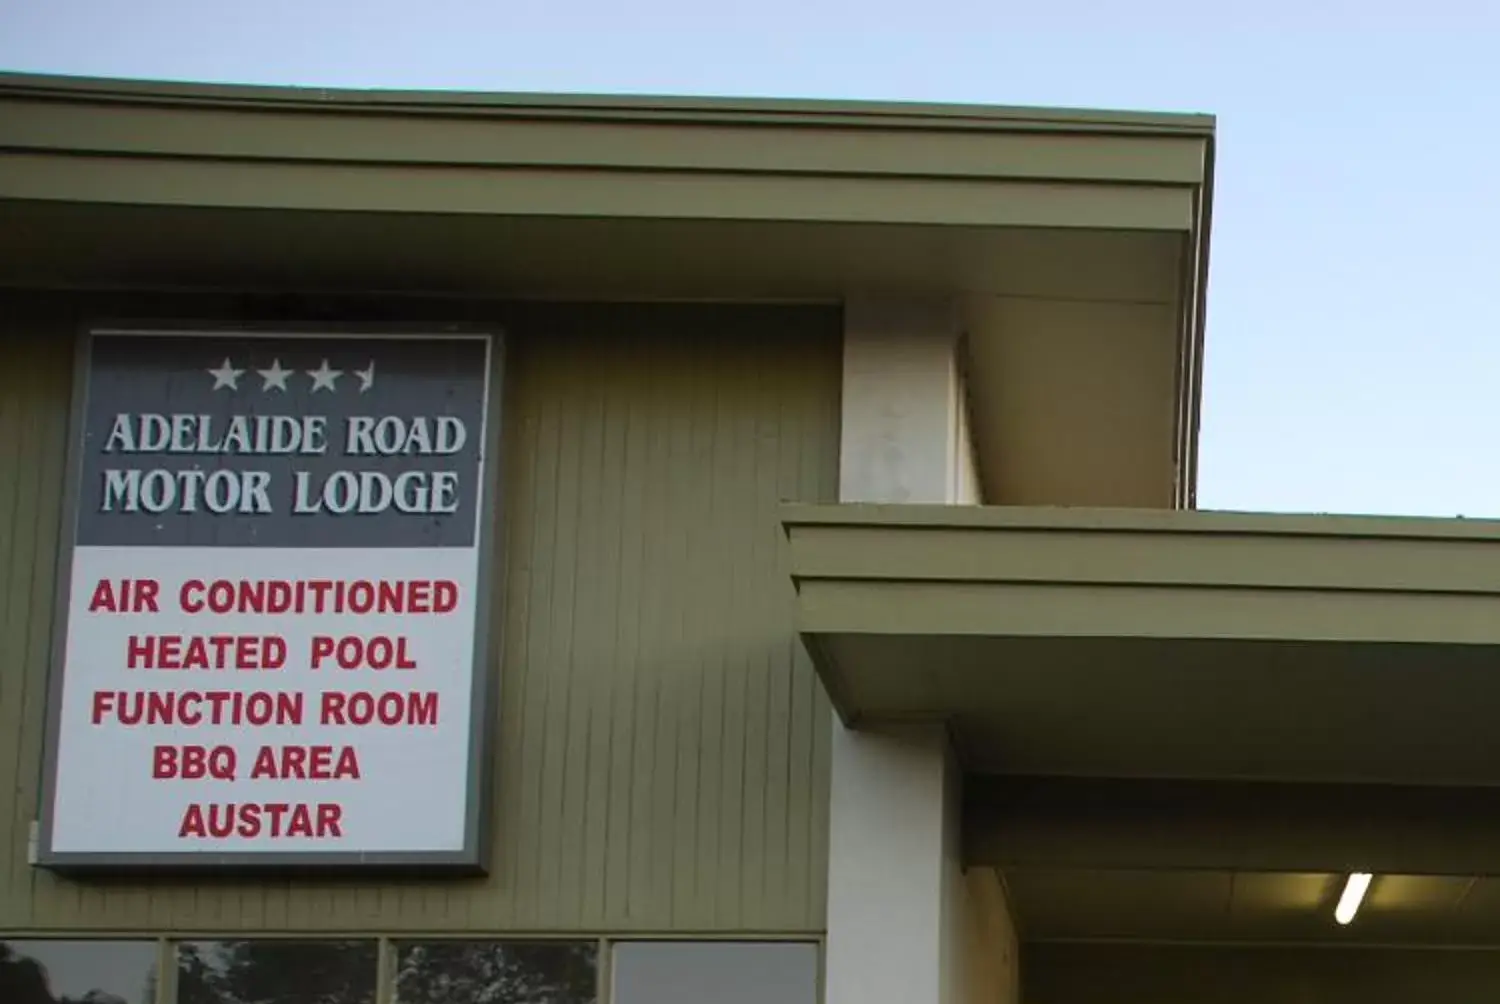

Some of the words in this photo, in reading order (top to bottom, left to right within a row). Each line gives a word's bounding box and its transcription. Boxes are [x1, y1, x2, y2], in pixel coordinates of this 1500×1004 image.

[104, 412, 327, 455] ADELAIDE
[346, 416, 467, 454] ROAD
[101, 469, 272, 515] MOTOR
[292, 471, 460, 516] LODGE
[88, 579, 160, 613] AIR
[178, 580, 459, 614] CONDITIONED
[126, 636, 288, 670] HEATED
[310, 636, 418, 670] POOL
[91, 691, 304, 726] FUNCTION
[319, 692, 438, 727] ROOM
[151, 746, 237, 782] BBQ
[250, 747, 361, 780] AREA
[177, 804, 343, 838] AUSTAR
